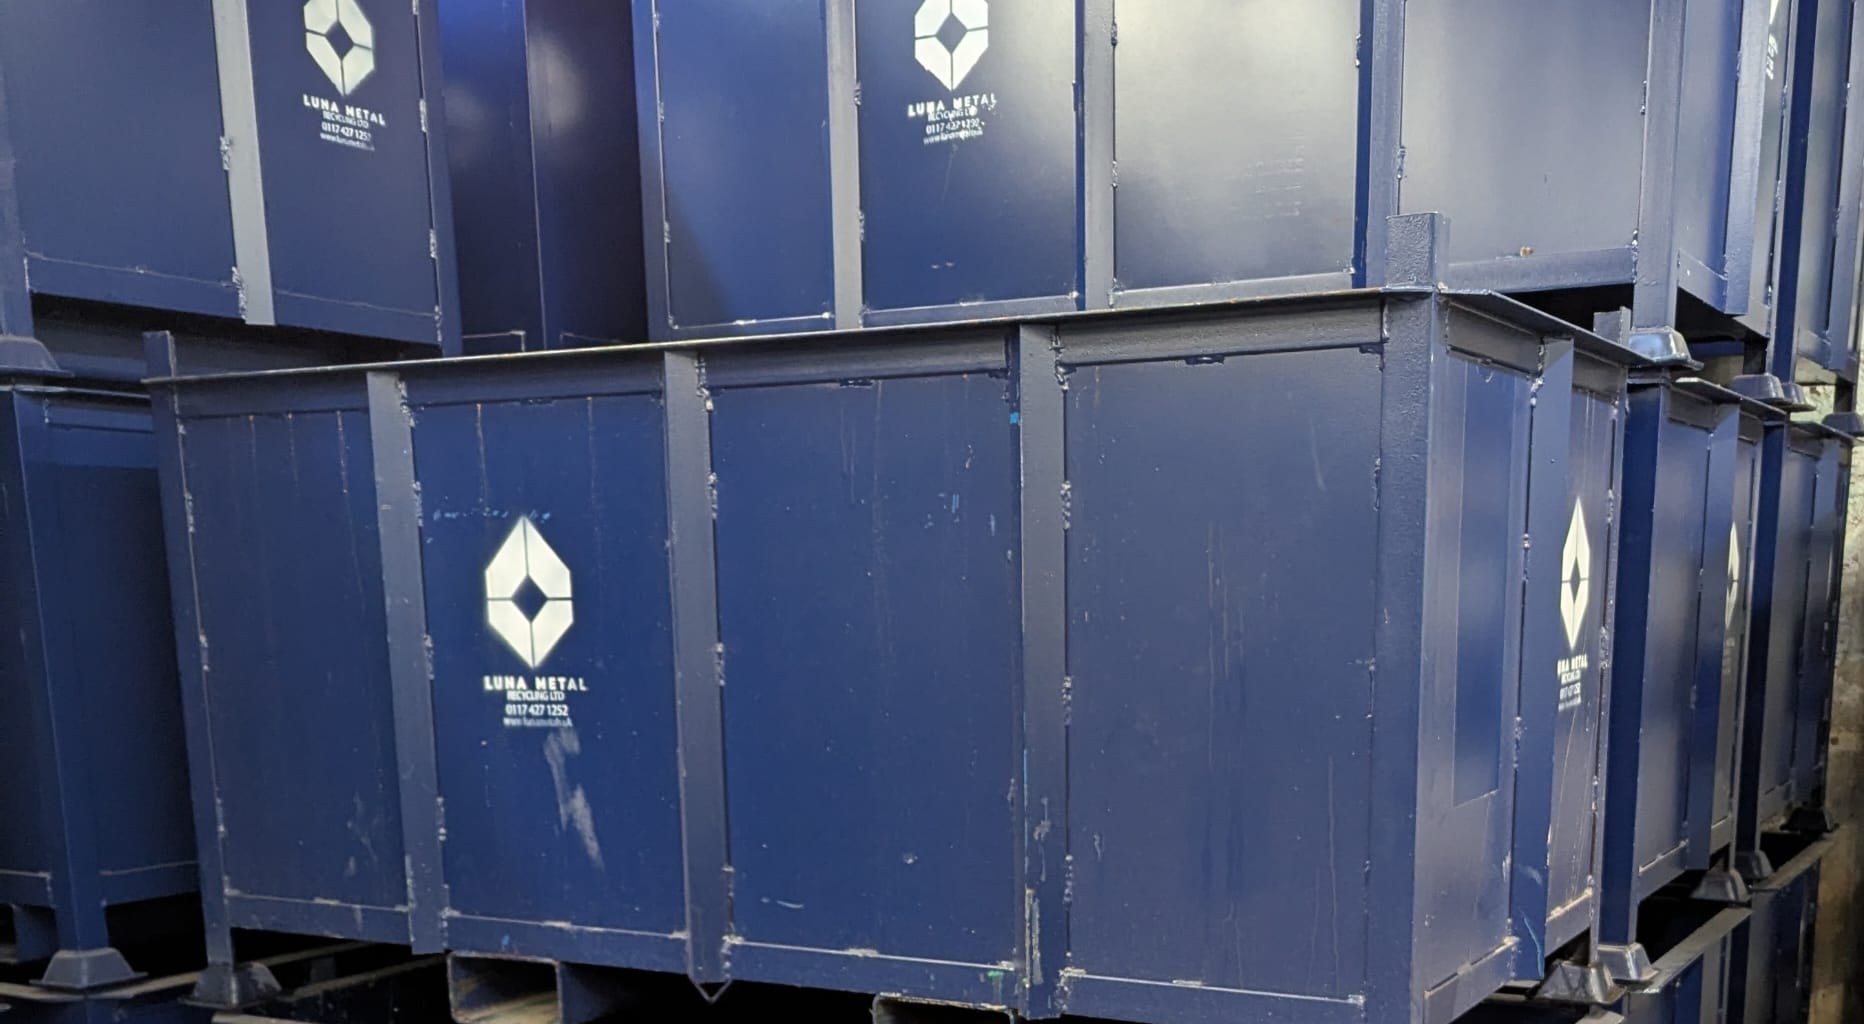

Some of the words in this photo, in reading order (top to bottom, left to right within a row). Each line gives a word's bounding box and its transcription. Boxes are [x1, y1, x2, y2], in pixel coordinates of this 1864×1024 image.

[303, 94, 339, 113] LUNA
[345, 105, 386, 126] METAL
[907, 100, 945, 117] LUNA
[953, 92, 997, 110] METAL
[321, 121, 340, 134] 0117
[483, 675, 528, 691] LUNA
[535, 676, 589, 692] METAL
[506, 690, 548, 701] RECYCLING
[549, 691, 565, 701] LTD
[505, 703, 528, 716] 0117
[528, 704, 545, 716] 427
[547, 704, 569, 716] 1252
